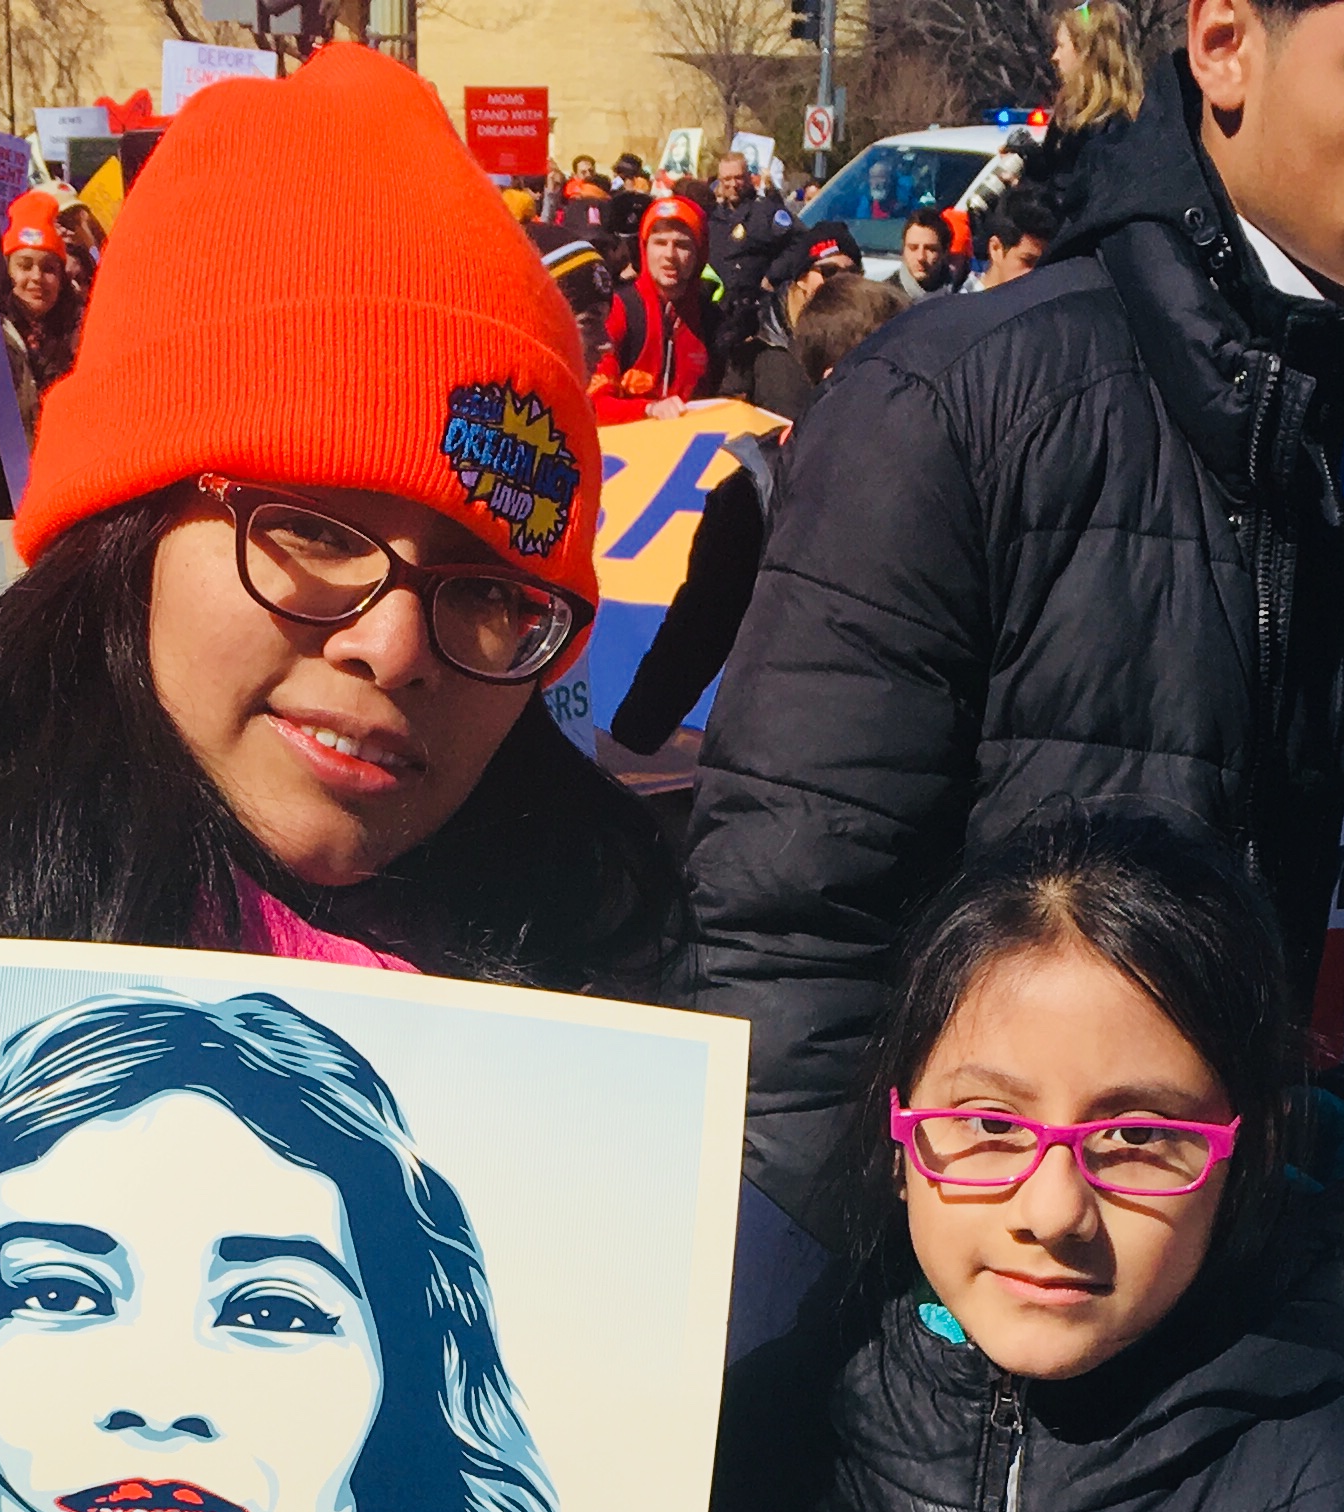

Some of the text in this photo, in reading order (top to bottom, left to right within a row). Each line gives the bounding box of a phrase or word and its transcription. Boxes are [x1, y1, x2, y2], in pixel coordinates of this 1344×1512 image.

[487, 94, 525, 105] MOMS
[470, 109, 543, 120] STAND WITH
[476, 125, 538, 136] DREAMERS
